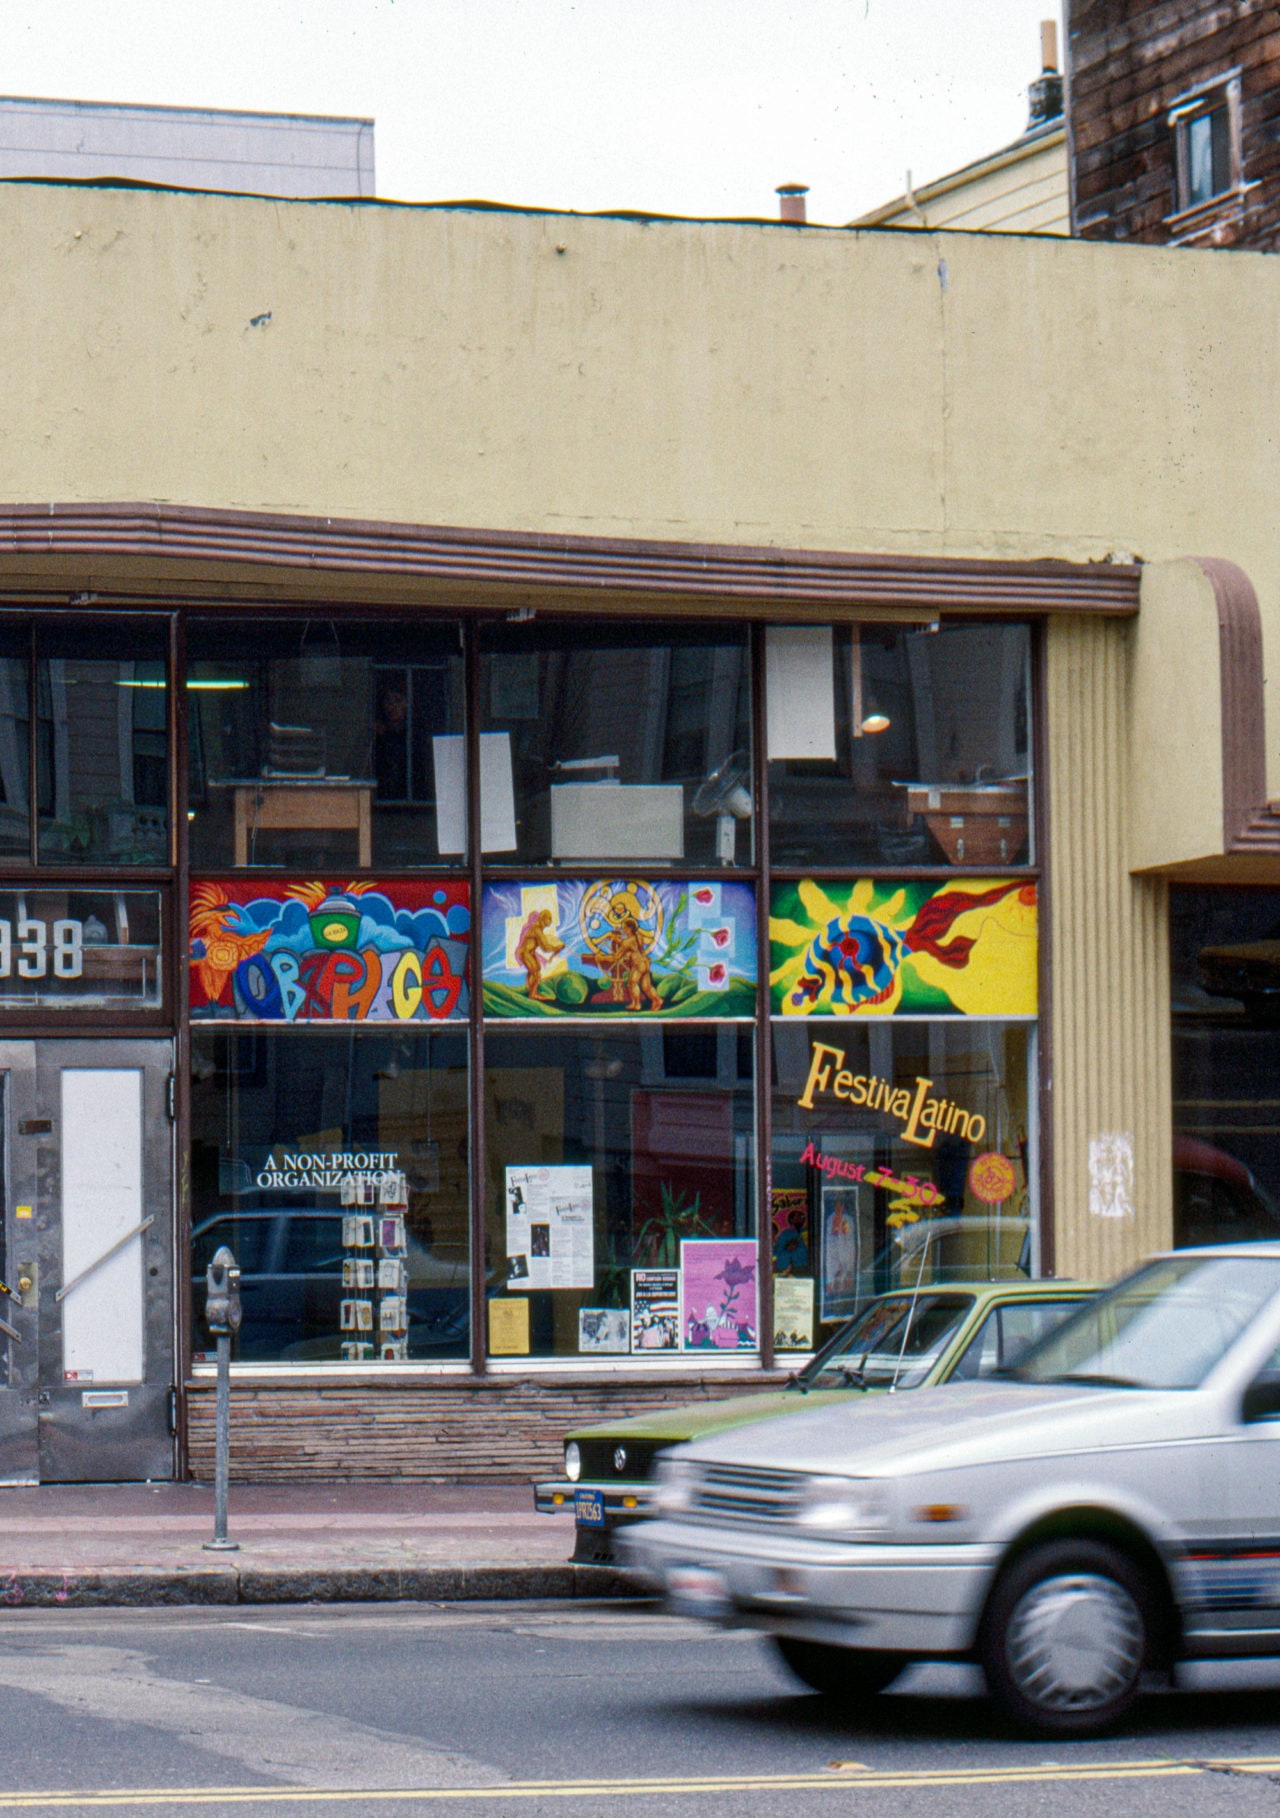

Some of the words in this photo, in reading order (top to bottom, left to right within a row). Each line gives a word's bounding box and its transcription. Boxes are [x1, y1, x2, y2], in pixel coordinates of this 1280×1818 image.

[264, 1153, 278, 1171] A
[283, 1152, 399, 1171] NON-PROFIT
[799, 1142, 866, 1183] August
[256, 1169, 402, 1188] ORGANIZATION
